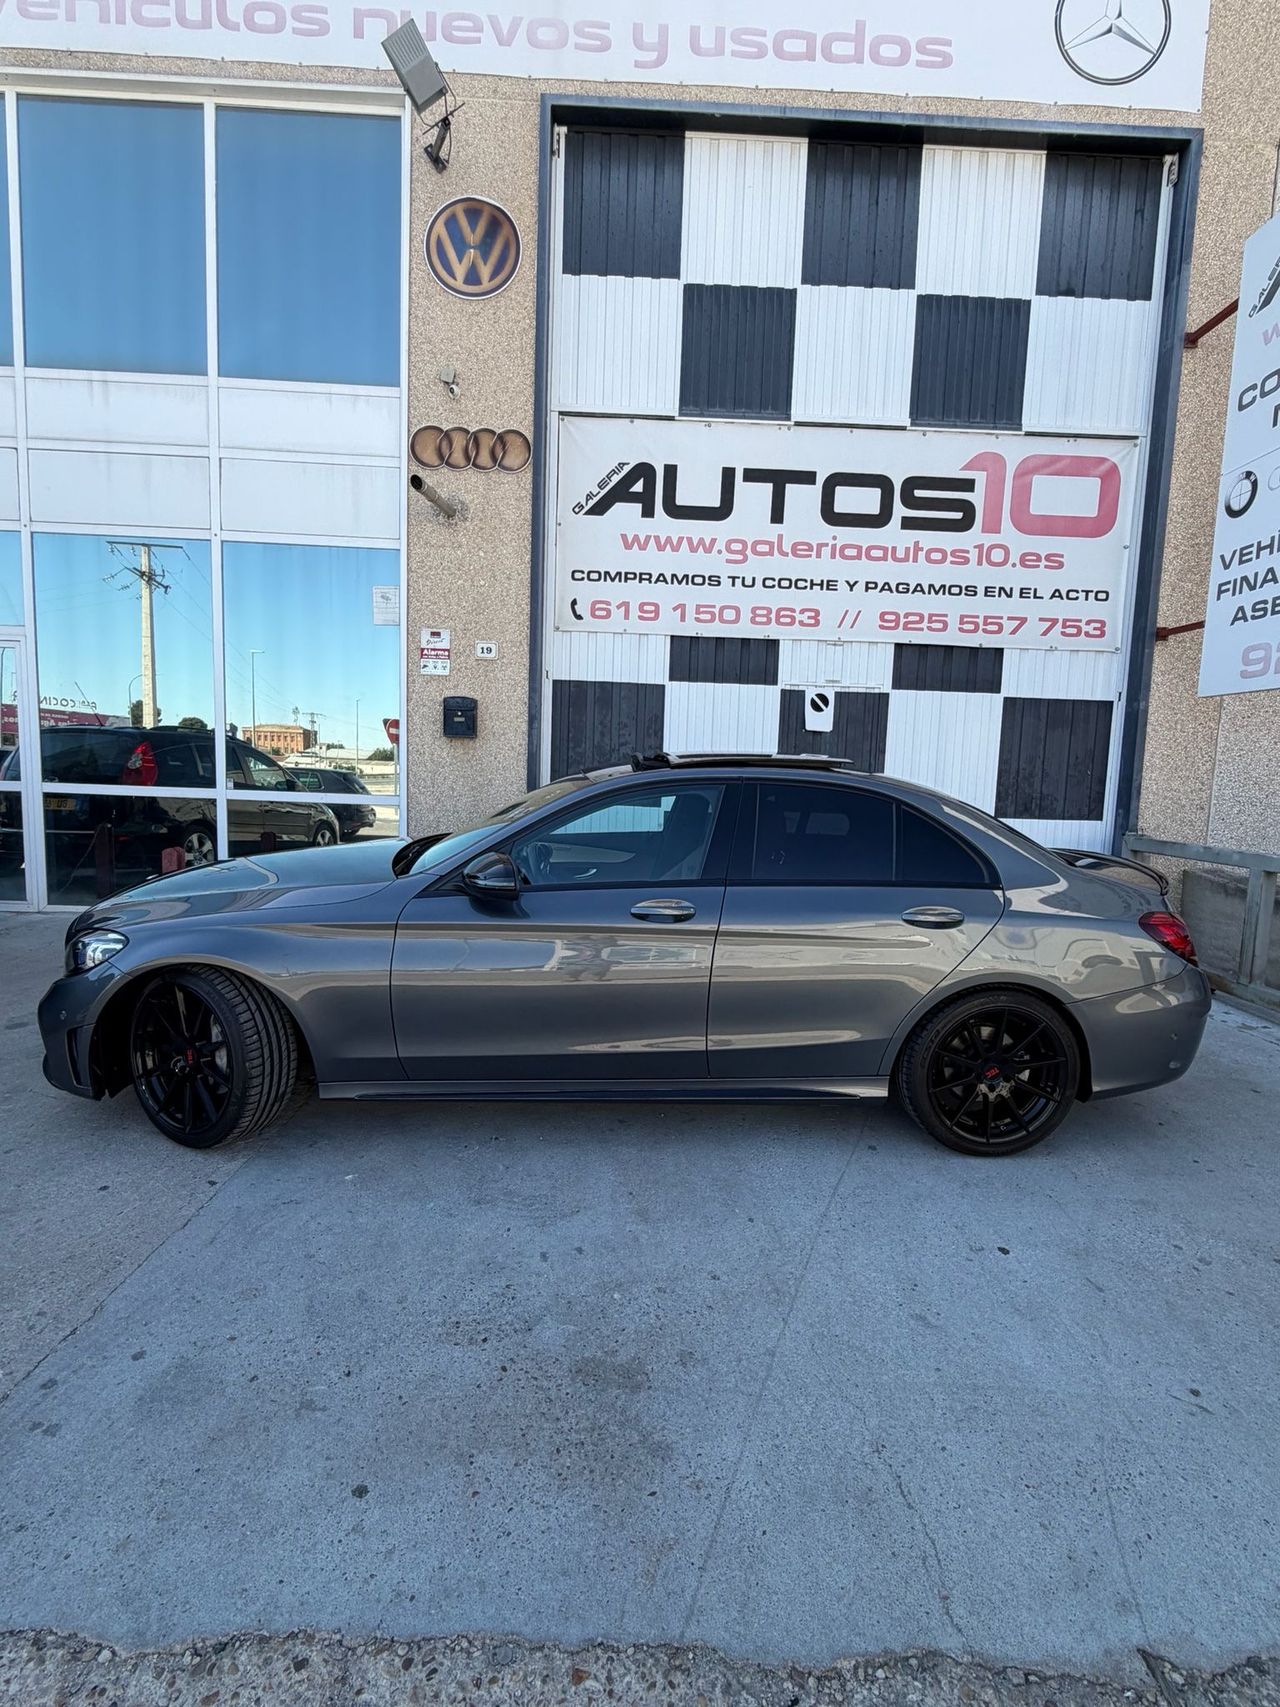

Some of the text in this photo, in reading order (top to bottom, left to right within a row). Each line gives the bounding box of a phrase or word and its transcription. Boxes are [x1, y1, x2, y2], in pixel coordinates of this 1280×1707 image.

[632, 22, 669, 69] y
[689, 20, 954, 69] usados
[572, 461, 630, 515] GALERIA
[620, 533, 1065, 571] www.galeriaautos10.es
[570, 569, 1110, 602] COMPRAMOS TU COCHE Y PAGAMOS EN EL ACTO
[589, 600, 660, 622] 619
[671, 603, 741, 625] 150
[750, 606, 821, 628] 863
[878, 610, 949, 632] 925
[957, 614, 1028, 636] 557
[1038, 617, 1107, 639] 753
[480, 646, 492, 655] 19
